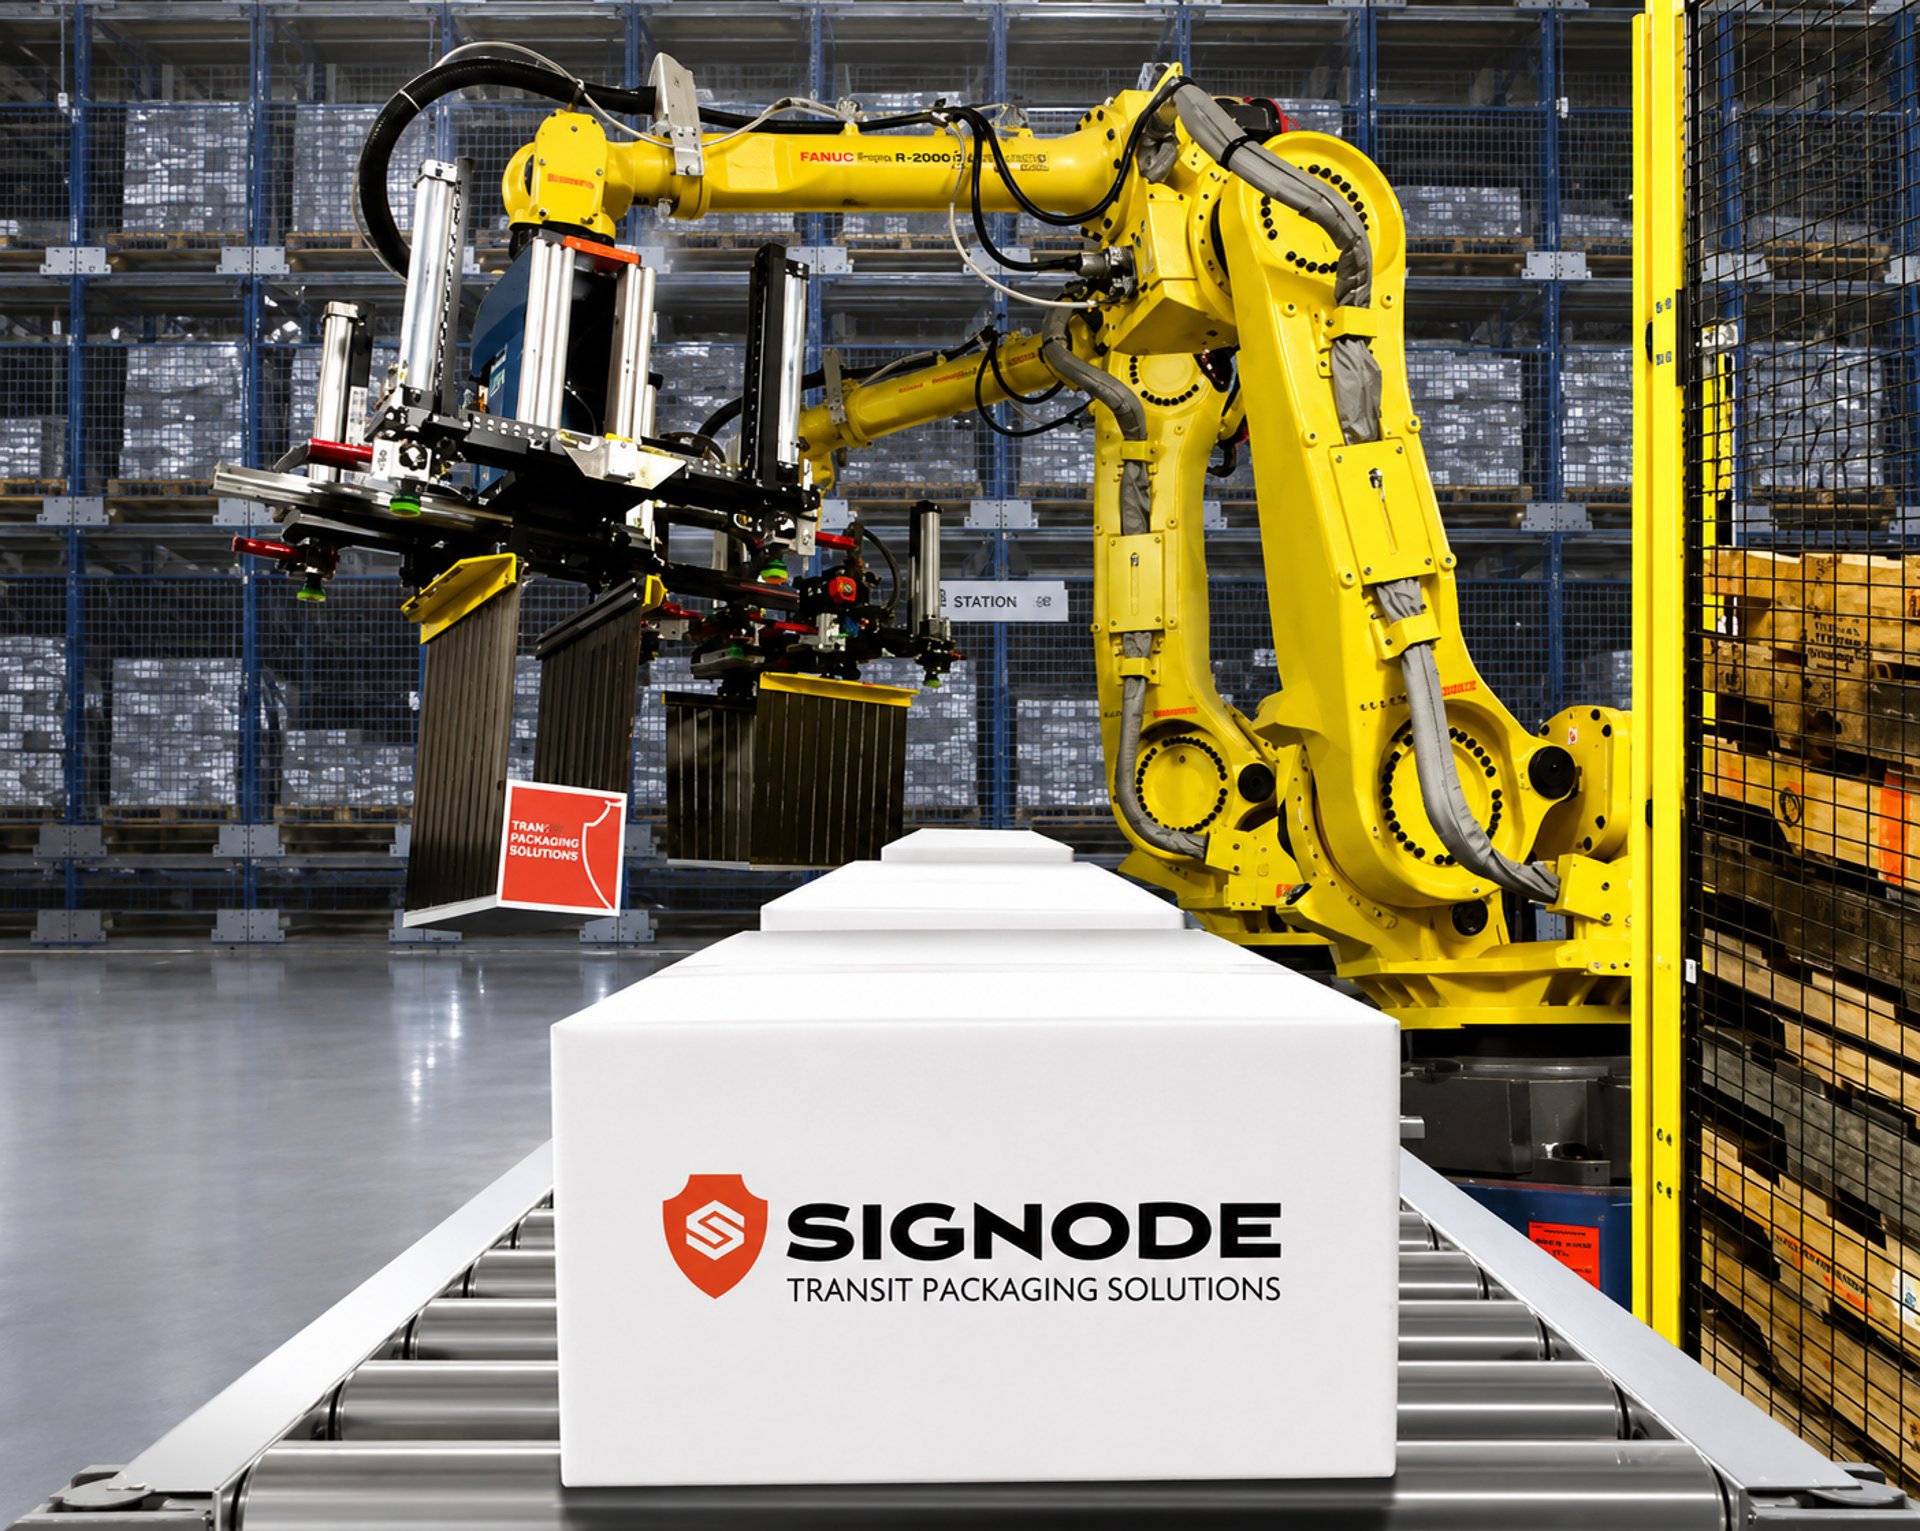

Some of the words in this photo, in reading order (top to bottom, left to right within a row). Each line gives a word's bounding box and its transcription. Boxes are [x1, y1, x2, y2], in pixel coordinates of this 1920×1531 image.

[800, 151, 854, 162] FANUC
[953, 595, 1017, 608] STATION
[510, 832, 579, 849] PACKAGING
[509, 845, 579, 861] SOLUTIONS
[787, 1202, 1281, 1261] SIGNODE
[787, 1278, 913, 1302] TRANSIT
[924, 1277, 1097, 1302] PACKAGING
[1109, 1277, 1281, 1302] SOLUTIONS
